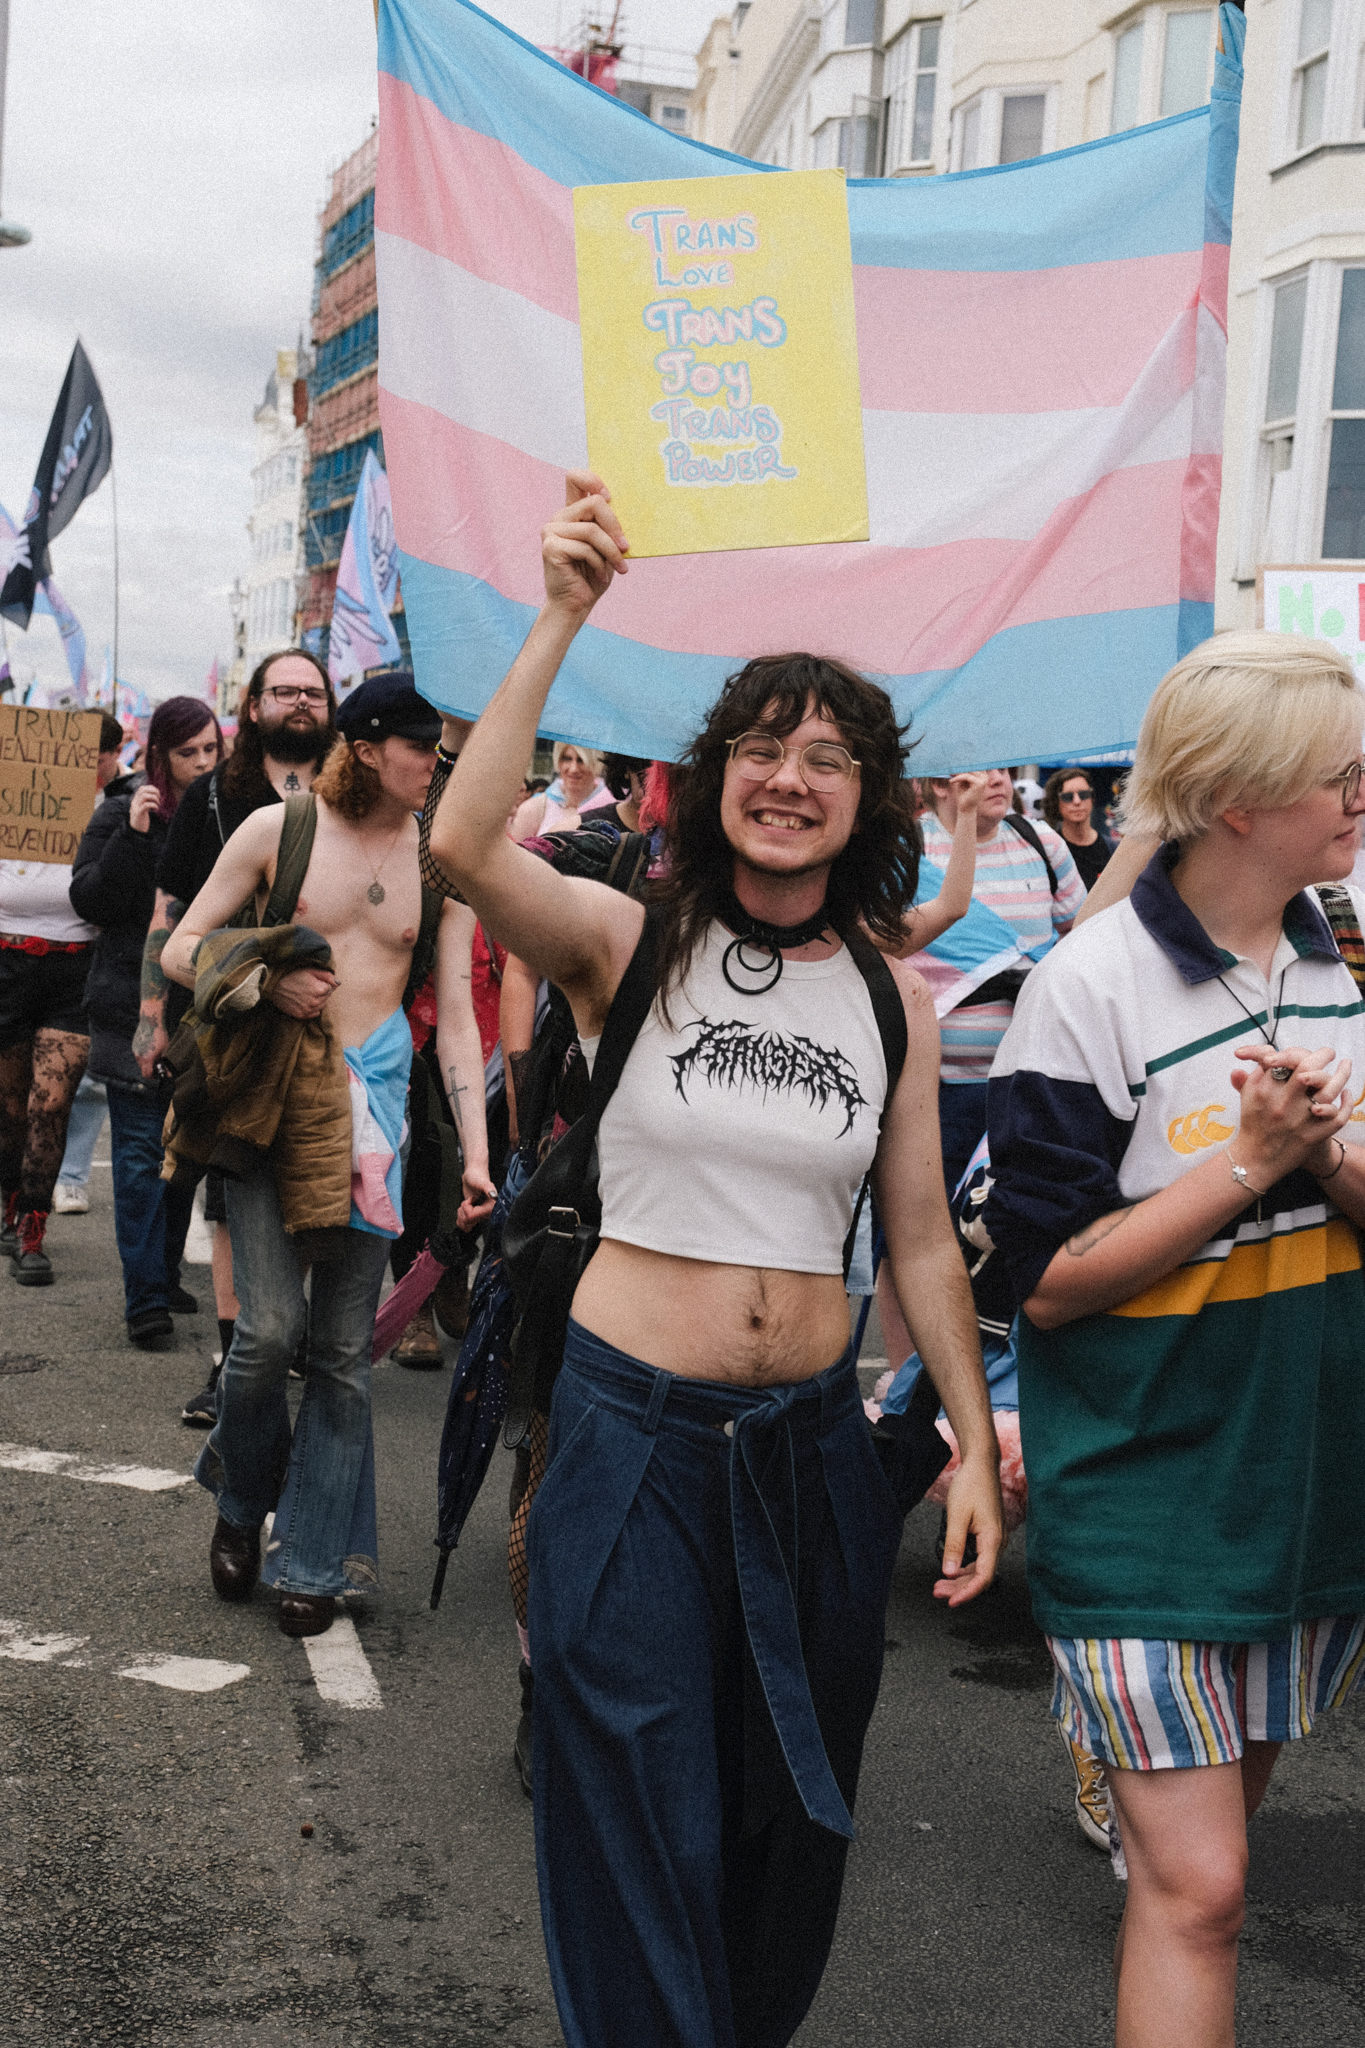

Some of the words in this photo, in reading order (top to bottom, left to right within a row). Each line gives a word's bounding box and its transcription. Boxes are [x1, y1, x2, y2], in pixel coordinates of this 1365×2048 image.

[629, 207, 758, 253] TRANS
[655, 256, 732, 288] LOVE
[643, 297, 787, 348] TRANS
[651, 398, 781, 444] TRANS
[662, 440, 797, 482] POWER
[10, 708, 82, 742] TRANS
[0, 735, 98, 769] EALTHCARE
[31, 768, 51, 790] IS
[0, 788, 72, 821] SUICIDE
[0, 824, 86, 857] REVENTION
